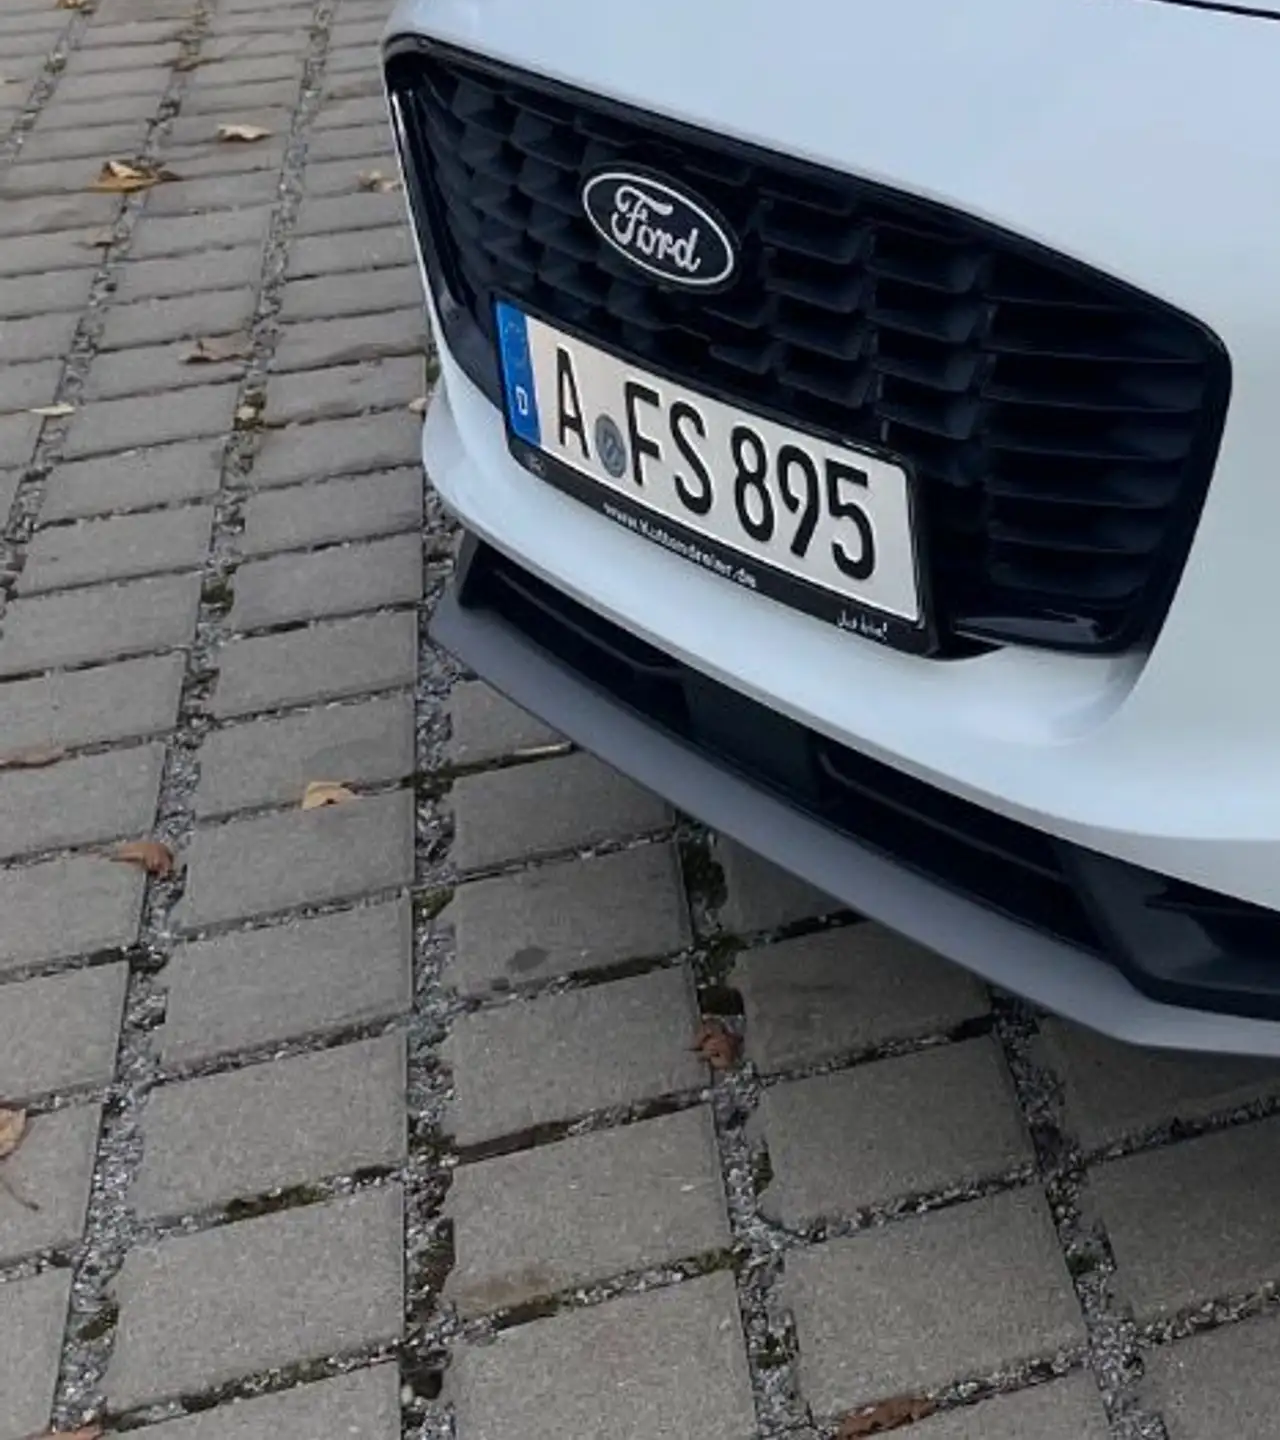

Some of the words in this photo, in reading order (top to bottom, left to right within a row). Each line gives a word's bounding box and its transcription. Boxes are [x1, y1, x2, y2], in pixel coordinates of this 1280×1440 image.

[610, 185, 701, 273] Ford
[556, 346, 590, 460] A
[624, 380, 713, 517] FS
[730, 424, 876, 581] 895
